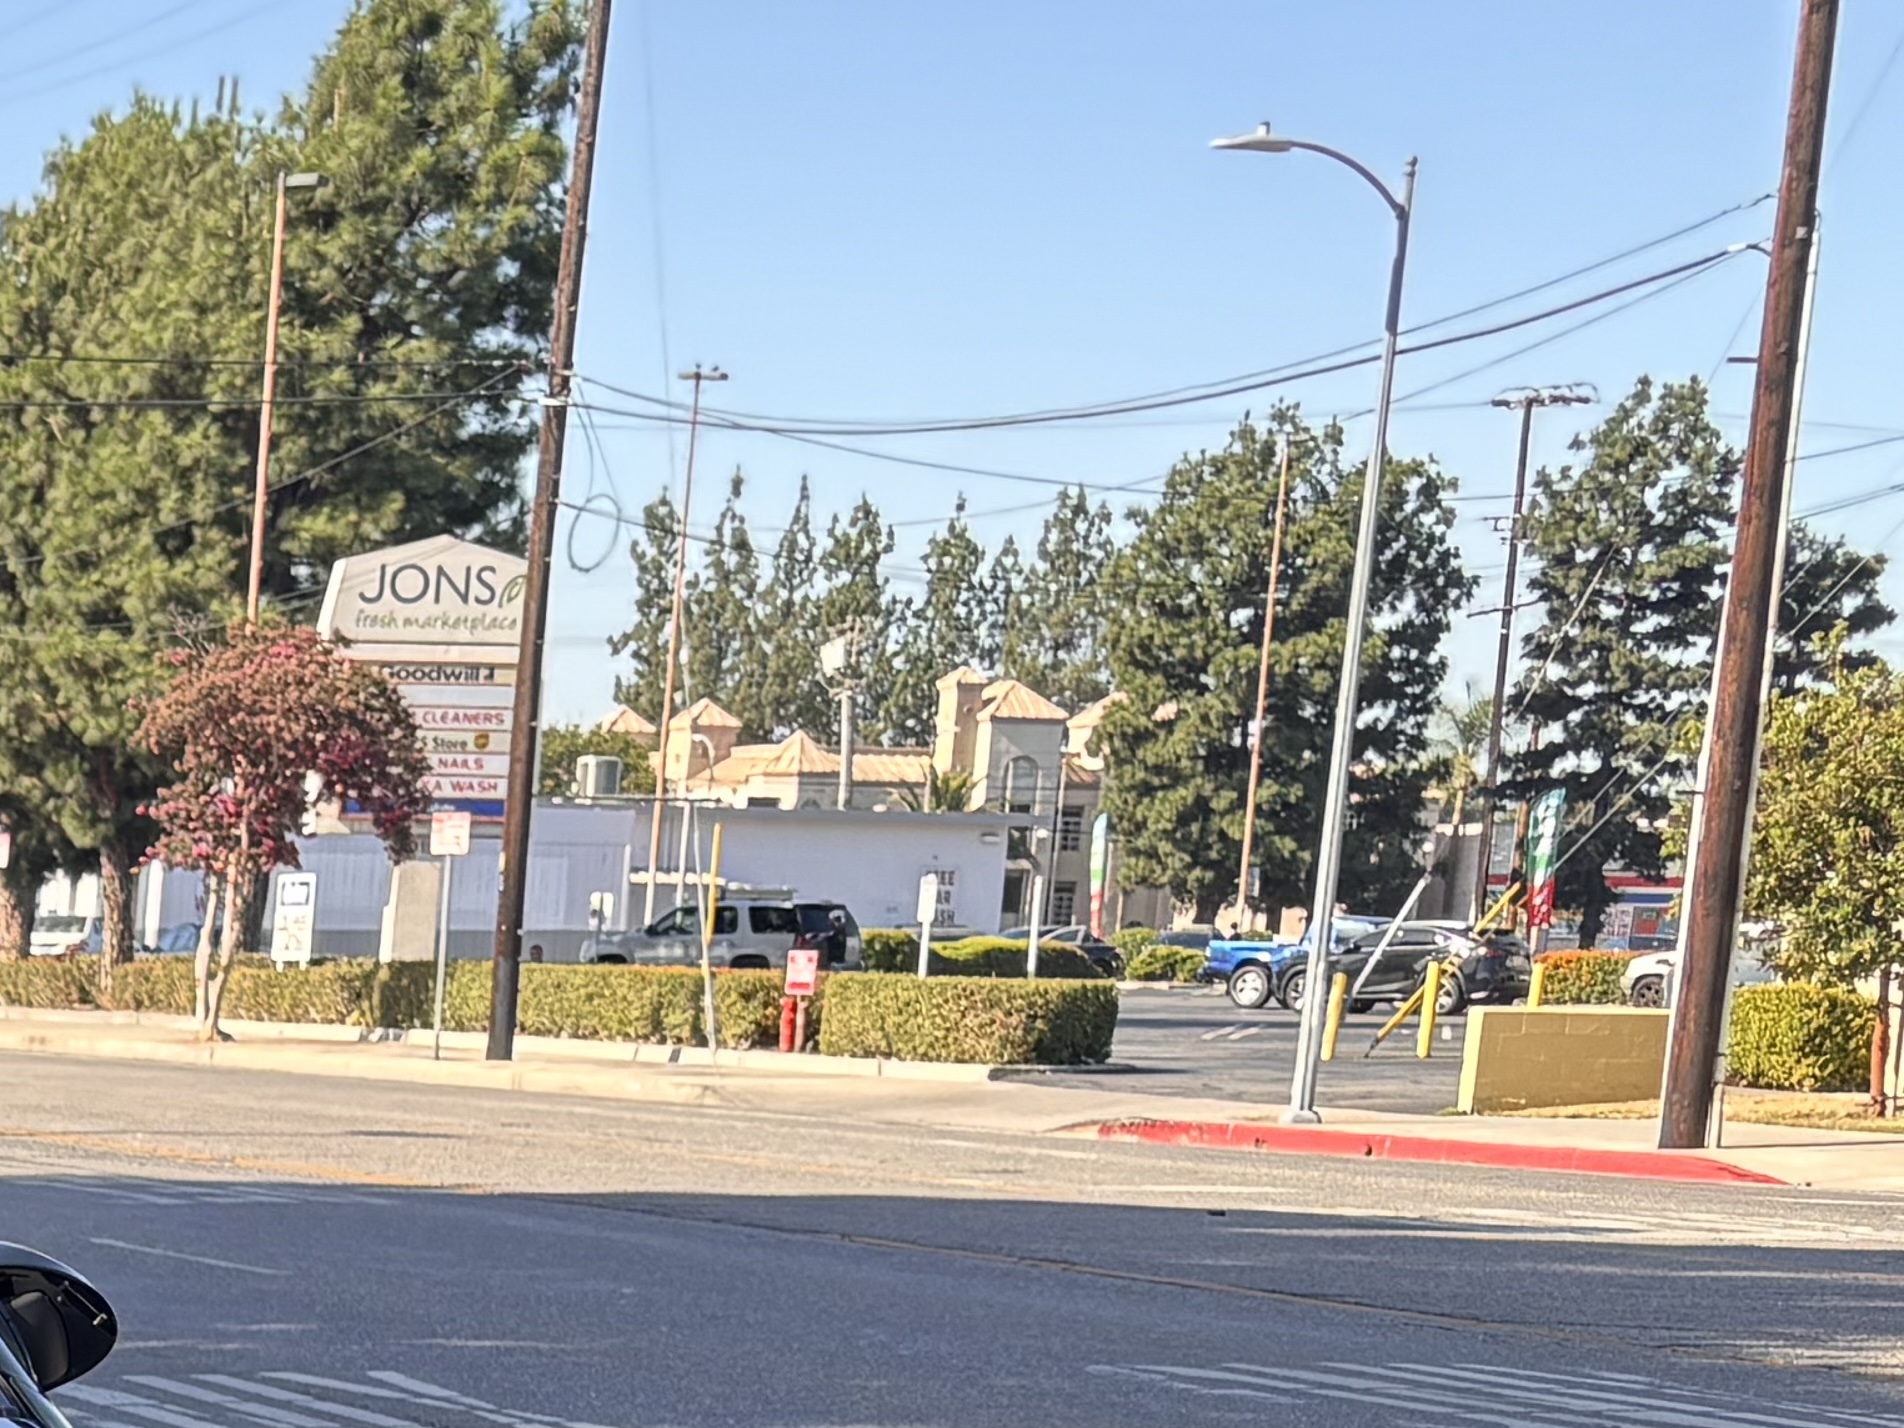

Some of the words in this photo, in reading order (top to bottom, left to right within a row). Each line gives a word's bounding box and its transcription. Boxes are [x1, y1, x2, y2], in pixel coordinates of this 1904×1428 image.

[357, 562, 498, 606] JONS
[355, 609, 398, 630] fresh
[402, 611, 517, 637] marketplace
[422, 710, 505, 725] CLEANERS
[432, 737, 468, 750] Store
[438, 757, 484, 770] NAILS
[450, 780, 498, 793] WASH
